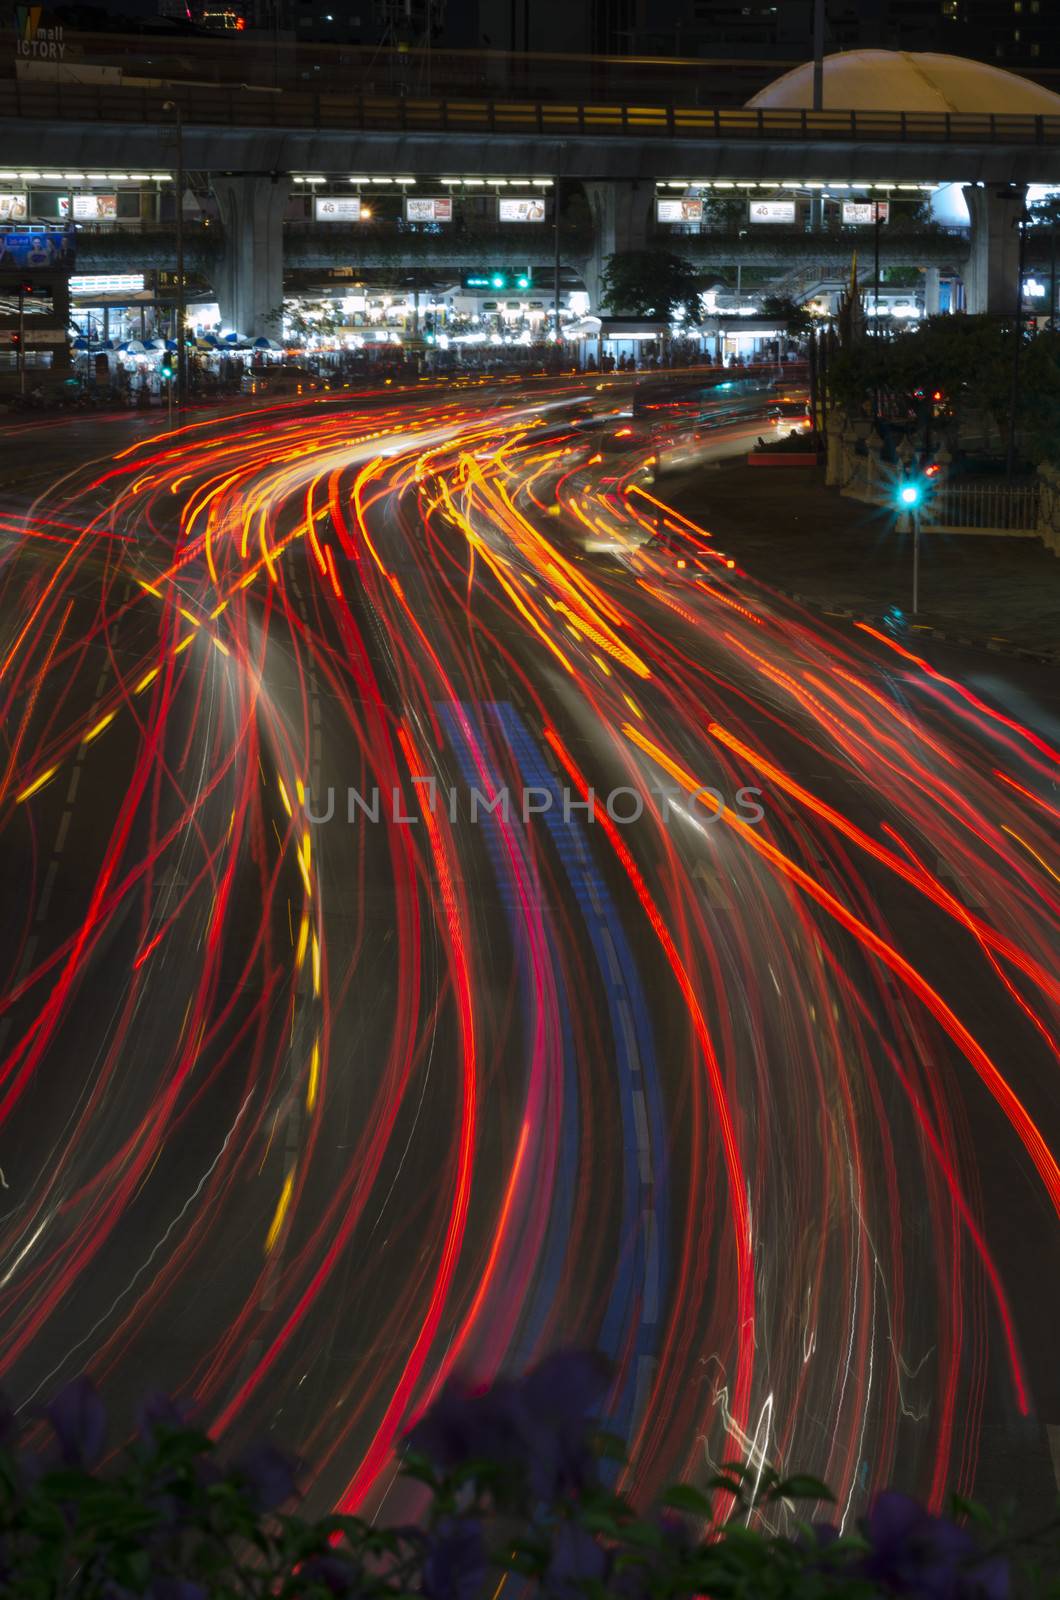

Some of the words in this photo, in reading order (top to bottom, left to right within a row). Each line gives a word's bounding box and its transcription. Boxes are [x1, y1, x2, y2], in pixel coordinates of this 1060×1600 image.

[37, 25, 63, 41] mall
[322, 203, 335, 213] 4G
[756, 207, 769, 216] 4G
